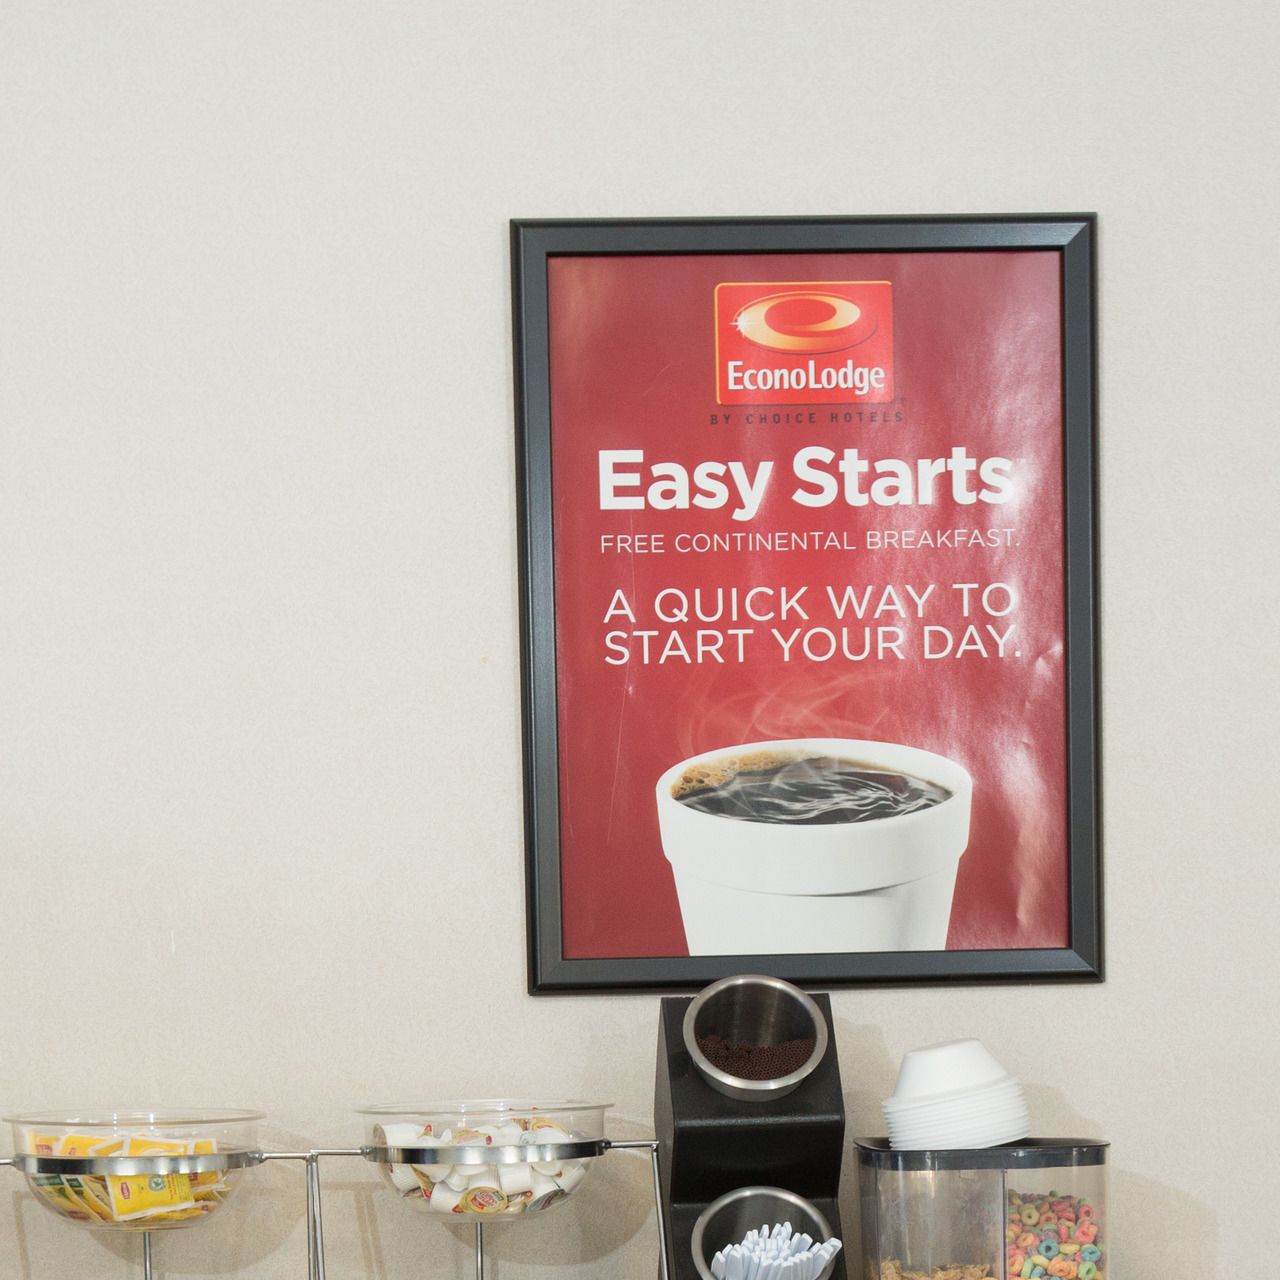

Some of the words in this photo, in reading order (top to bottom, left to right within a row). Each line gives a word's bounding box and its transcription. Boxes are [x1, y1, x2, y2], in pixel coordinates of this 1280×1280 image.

[727, 359, 885, 395] EconoLodge
[710, 414, 732, 425] BY
[746, 412, 816, 425] CHOICE
[831, 411, 904, 423] HOTELS
[598, 448, 774, 521] Easy
[792, 446, 1014, 508] Starts
[600, 533, 665, 553] FREE
[675, 530, 856, 552] CONTINENTAL
[866, 528, 1021, 550] BREAKFAST.
[604, 588, 636, 624] A
[654, 585, 810, 623] QUICK
[826, 585, 936, 620] WAY
[952, 582, 1016, 617] TO
[604, 629, 754, 665] START
[771, 625, 904, 662] YOUR
[923, 623, 1022, 659] DAY.
